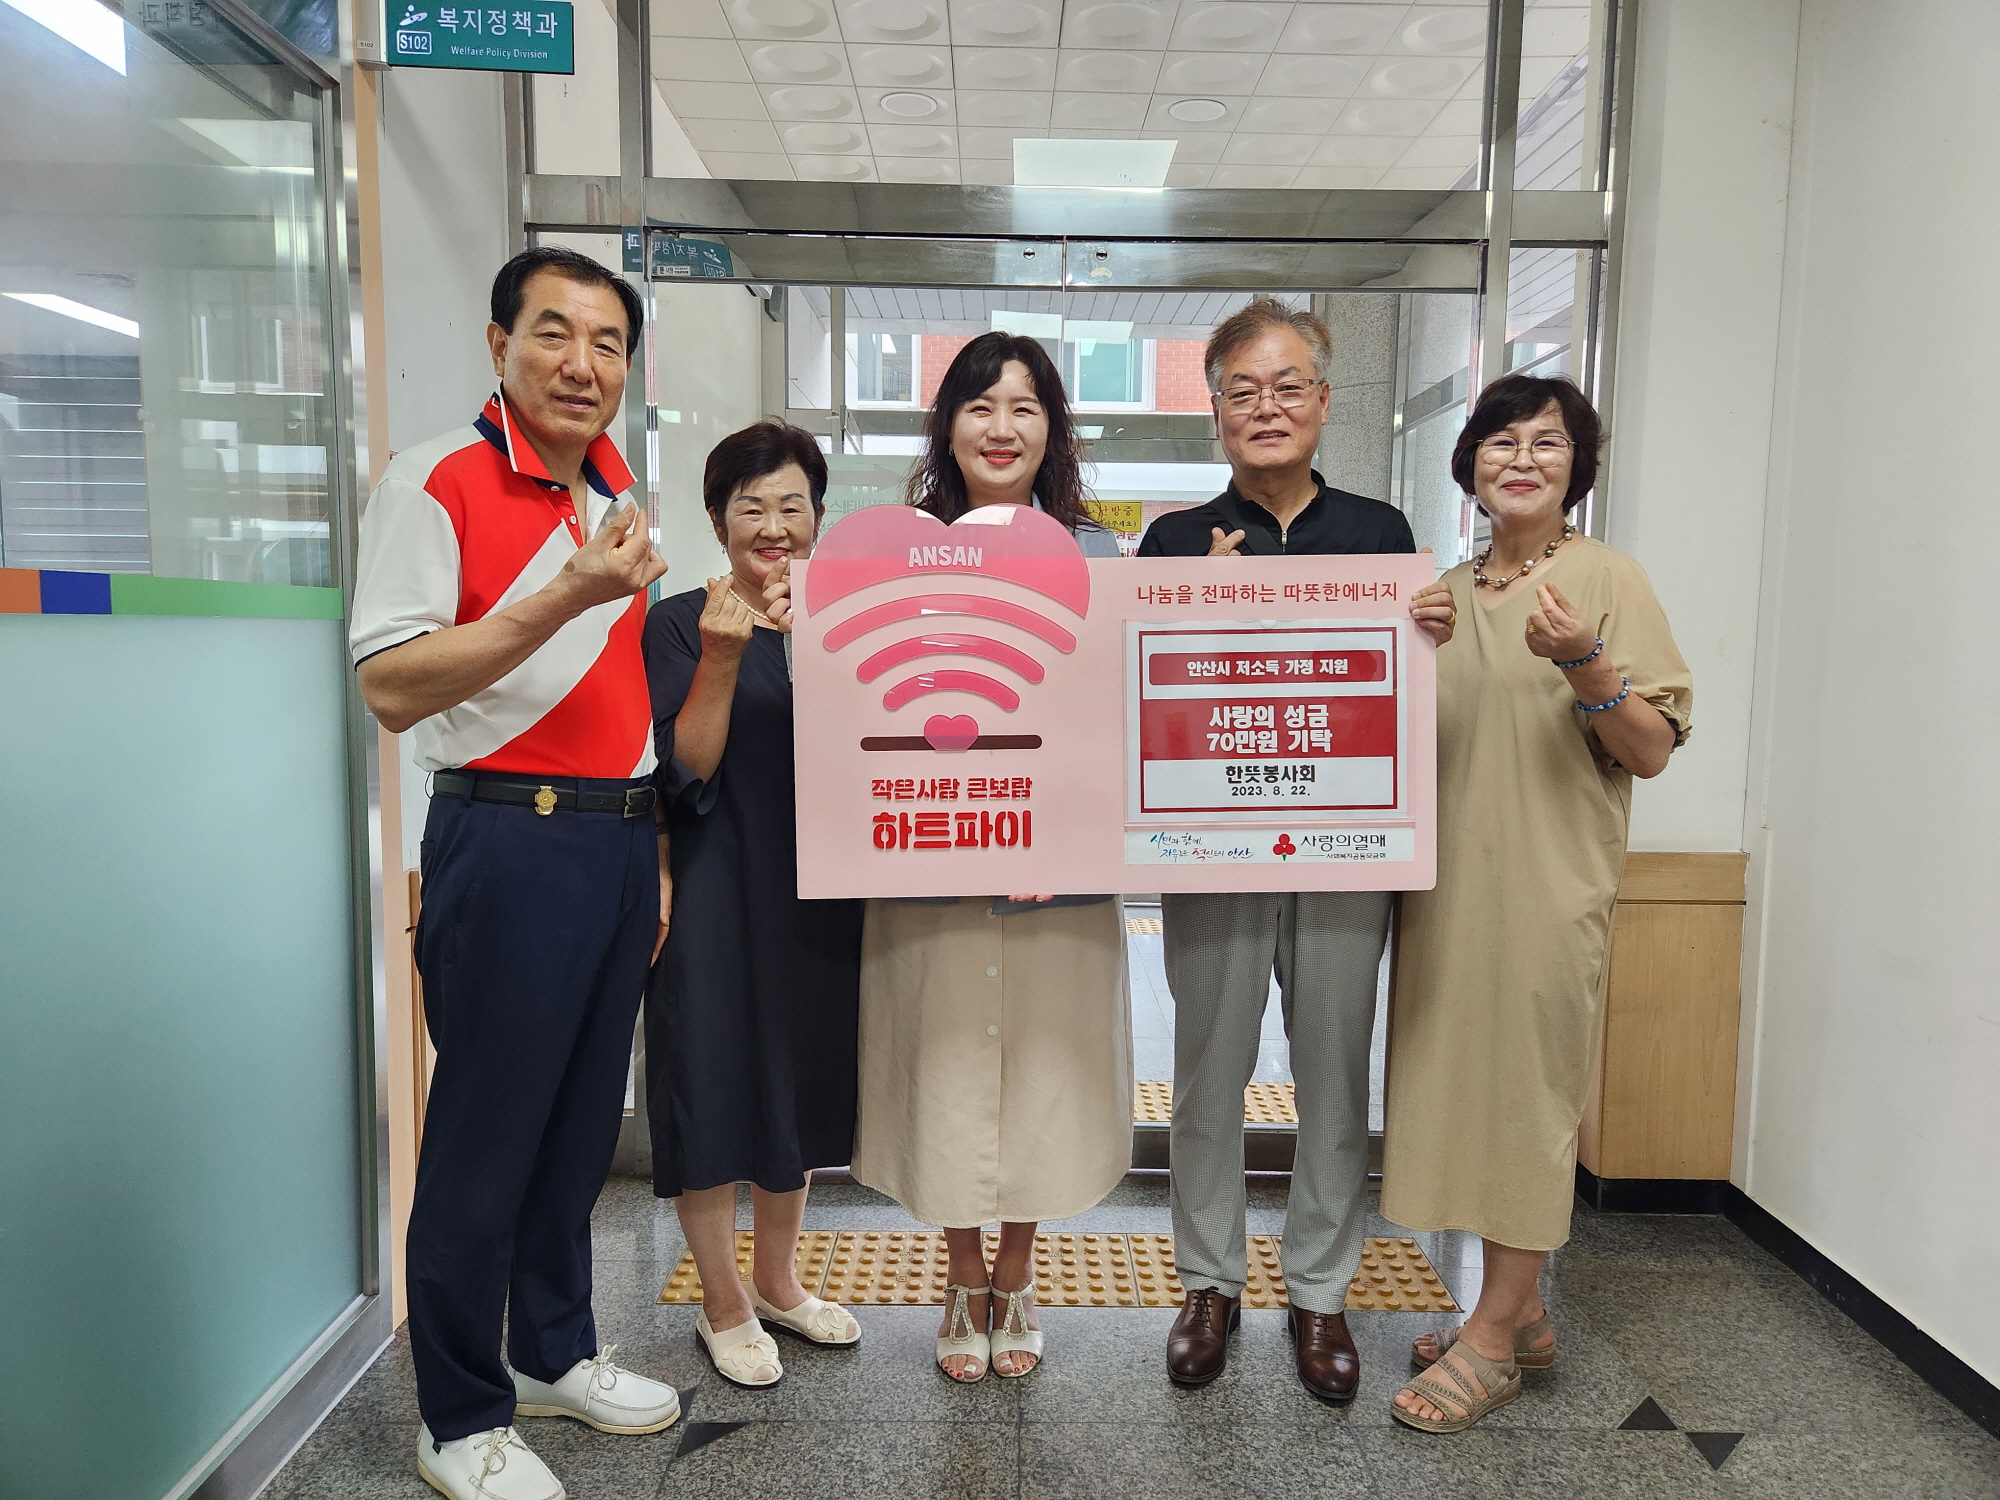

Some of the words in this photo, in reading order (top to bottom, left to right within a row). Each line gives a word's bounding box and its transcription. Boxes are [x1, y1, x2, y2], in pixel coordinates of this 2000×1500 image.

[437, 7, 558, 39] 복지정책과
[399, 34, 428, 51] S102
[450, 45, 484, 57] Welfare
[486, 47, 511, 60] Policy
[514, 48, 549, 60] Division
[908, 545, 983, 568] ANSAN
[1137, 584, 1194, 605] 나눔을
[1201, 584, 1277, 604] 전파하는
[1284, 582, 1398, 603] 따뜻한에너지
[1187, 660, 1231, 678] 안산시
[1236, 659, 1280, 677] 저소득
[1285, 659, 1314, 676] 가정
[1319, 658, 1349, 675] 지원
[1209, 705, 1275, 730] 사랑의
[1283, 704, 1330, 729] 성금
[1206, 729, 1279, 754] 70만원
[1287, 729, 1334, 753] 기탁
[1225, 764, 1316, 784] 한뜻봉사회
[871, 778, 961, 800] 작은사랑
[967, 777, 1033, 800] 큰보람
[1231, 786, 1267, 797] 2023.
[1272, 785, 1285, 797] 8.
[1290, 785, 1311, 797] 22.
[872, 810, 1032, 850] 하트파이
[1227, 847, 1254, 860] 안산
[1301, 834, 1386, 853] 사랑의열매
